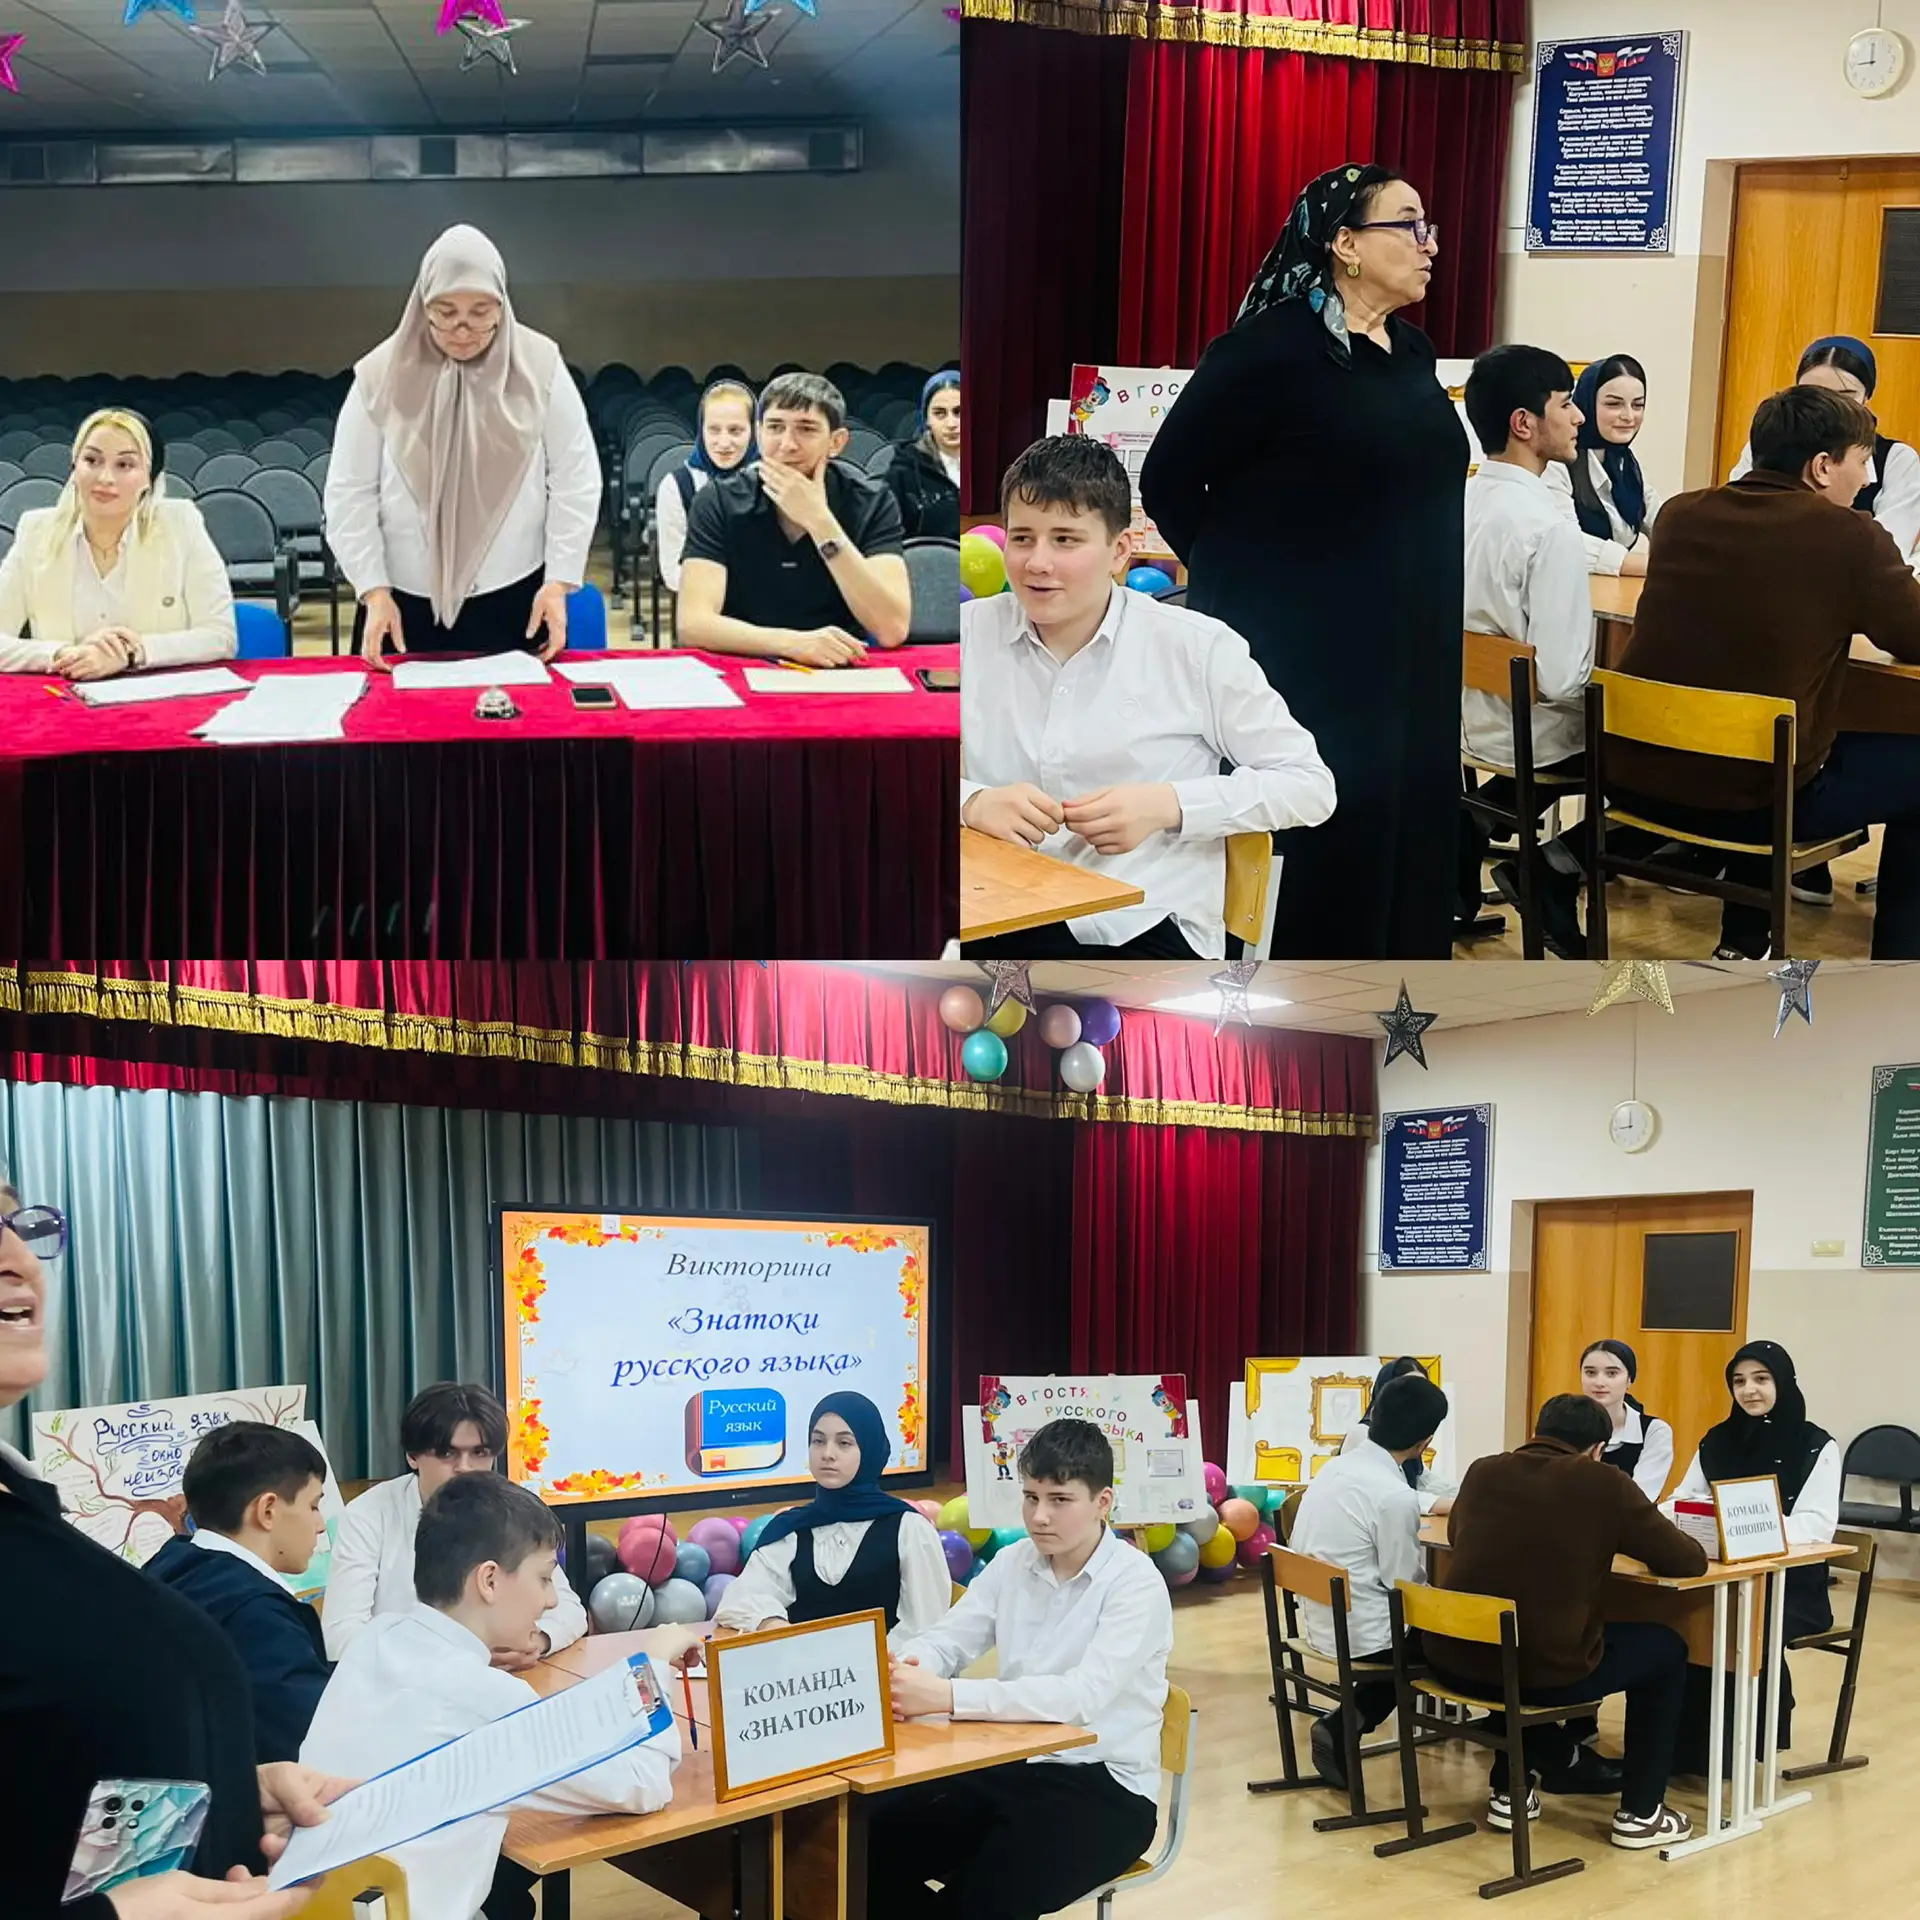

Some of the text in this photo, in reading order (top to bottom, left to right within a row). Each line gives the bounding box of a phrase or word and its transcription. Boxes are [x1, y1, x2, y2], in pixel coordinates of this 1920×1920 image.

[1117, 389, 1130, 404] В
[666, 1253, 832, 1283] Викторина
[668, 1307, 820, 1335] «Знатоки
[610, 1353, 862, 1387] русского языка»
[708, 1398, 777, 1417] Русский
[1016, 1394, 1028, 1406] В
[1044, 1405, 1127, 1422] РУССКОГО
[724, 1420, 762, 1433] язык
[1095, 1422, 1144, 1443] ЗЫКА
[152, 1447, 182, 1462] окно
[743, 1666, 857, 1707] КОМАНДА
[738, 1698, 865, 1742] «ЗНАТОКИ»
